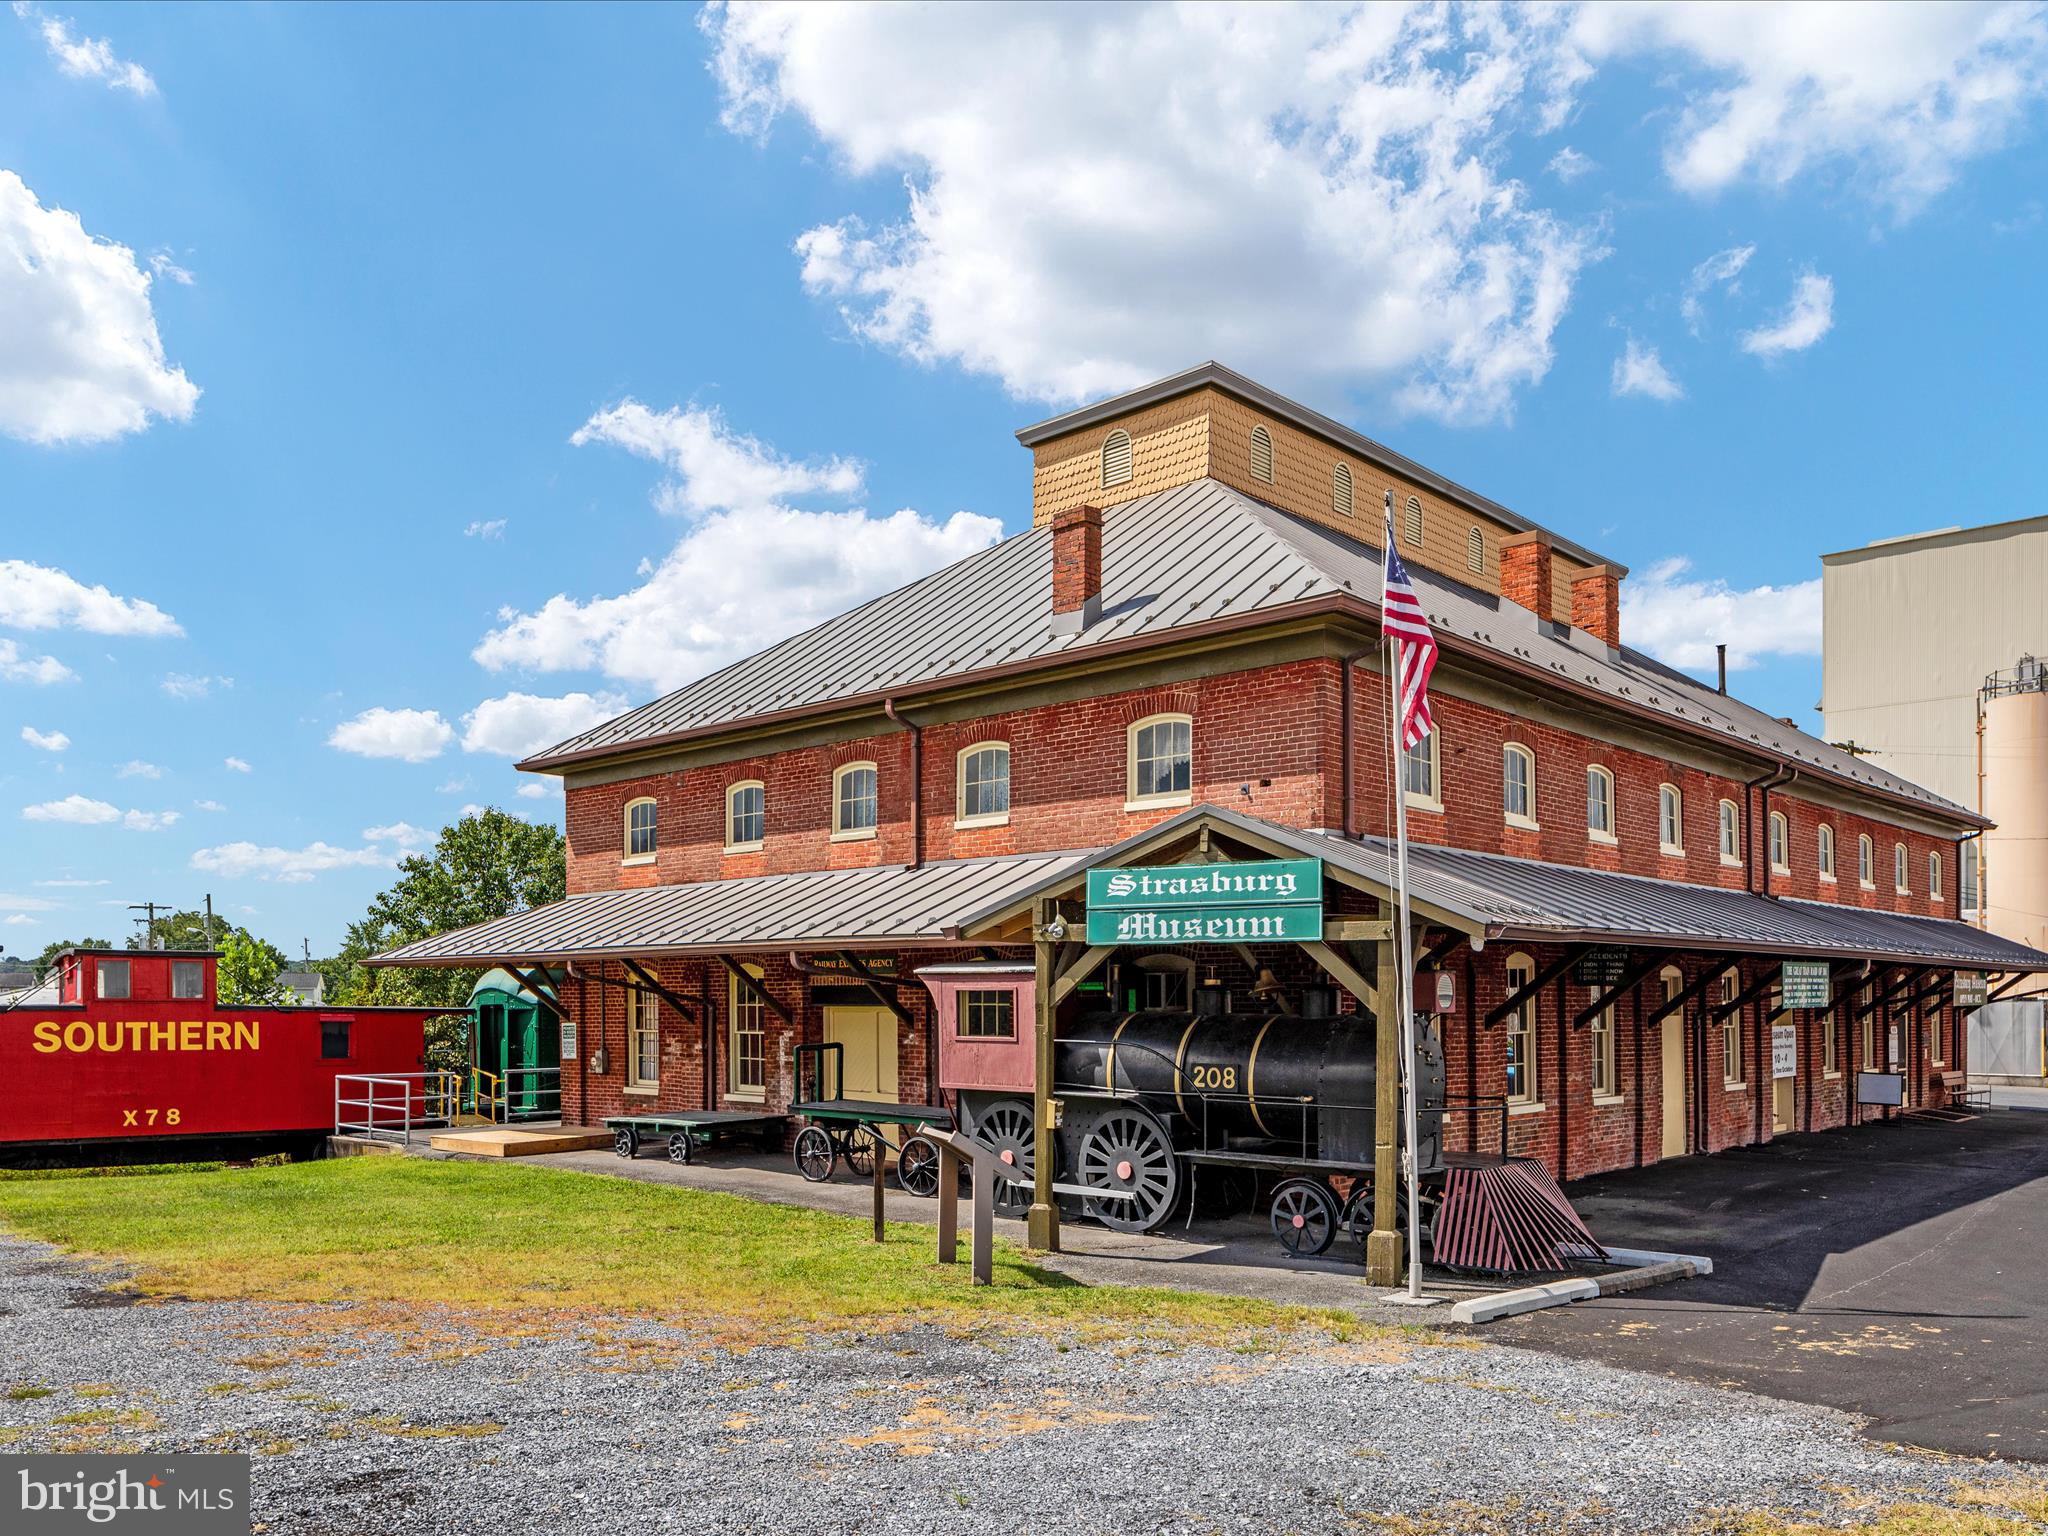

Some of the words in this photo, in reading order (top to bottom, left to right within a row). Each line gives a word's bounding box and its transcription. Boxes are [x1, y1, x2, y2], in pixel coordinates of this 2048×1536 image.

[1106, 870, 1298, 897] Strasburg
[1116, 911, 1286, 940] Museum
[868, 958, 894, 968] AGENCY
[32, 1021, 260, 1053] SOUTHERN
[1772, 1031, 1783, 1040] seum
[1784, 1028, 1794, 1041] Open
[1774, 1053, 1781, 1063] 10
[1193, 1065, 1236, 1089] 208
